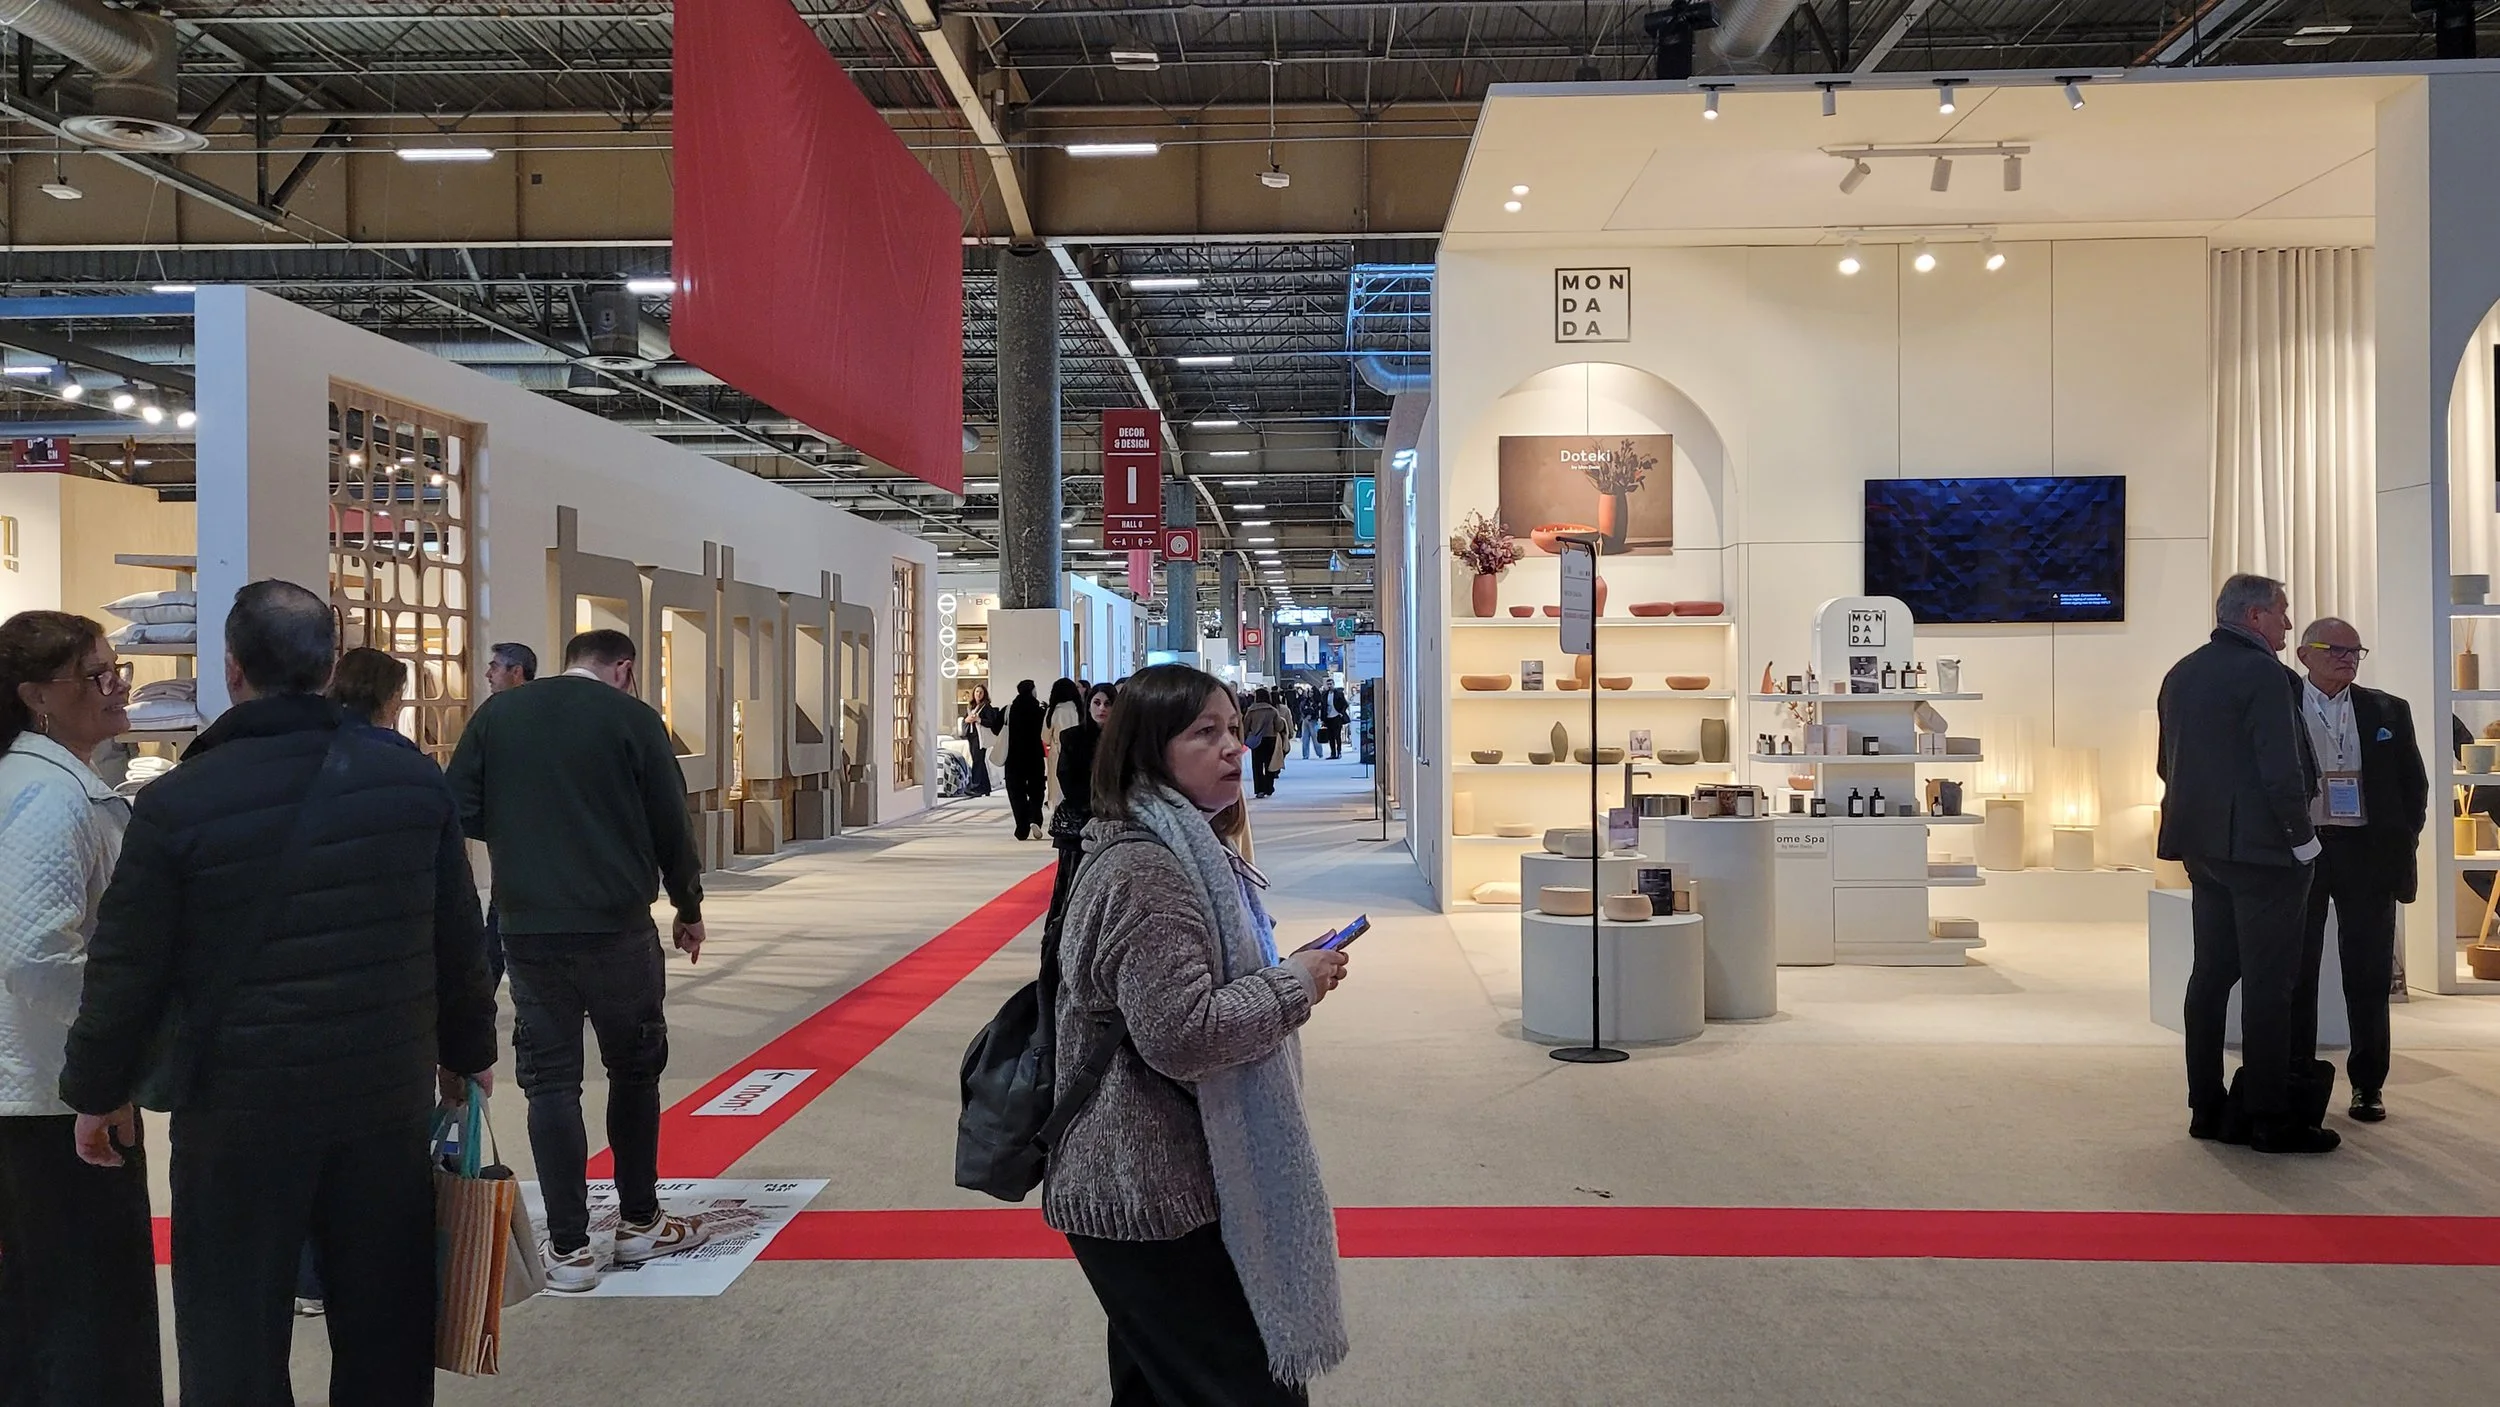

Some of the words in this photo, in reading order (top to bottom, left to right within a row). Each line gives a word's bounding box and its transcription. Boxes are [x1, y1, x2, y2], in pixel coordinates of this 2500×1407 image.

[1562, 275, 1624, 290] MON
[1562, 298, 1601, 313] DA
[1562, 321, 1601, 336] DA
[1119, 428, 1145, 437] DECOR
[1121, 439, 1150, 448] DESIGN
[1560, 449, 1611, 462] Doteki
[1121, 520, 1137, 528] HALL
[1121, 538, 1127, 546] A
[1852, 613, 1883, 622] MON
[1852, 625, 1871, 633] DA
[1852, 636, 1871, 644] DA
[1804, 834, 1825, 845] Spa
